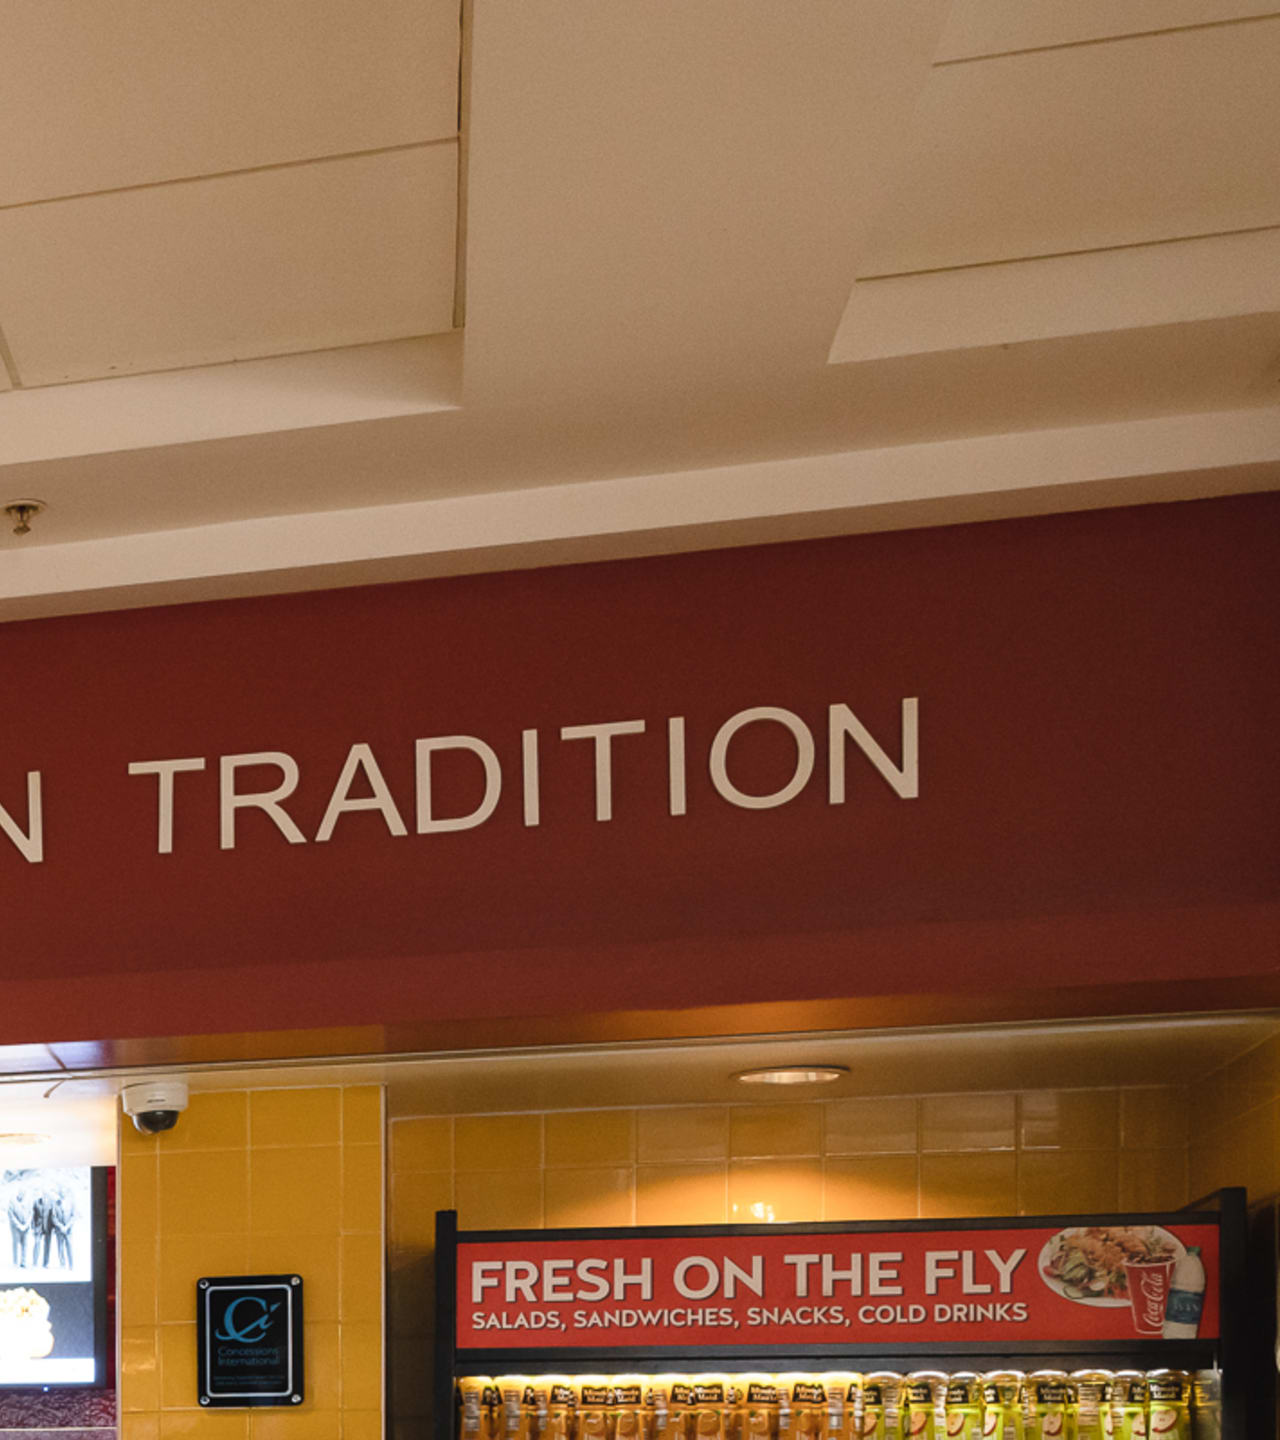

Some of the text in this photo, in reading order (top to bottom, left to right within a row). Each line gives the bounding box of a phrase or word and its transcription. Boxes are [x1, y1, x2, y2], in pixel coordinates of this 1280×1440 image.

[128, 697, 919, 854] TRADITION
[472, 1249, 1027, 1303] FRESH ON THE FLY
[472, 1302, 1029, 1332] SALADS, SANDWICHES, SNACKS, COLD DRINKS
